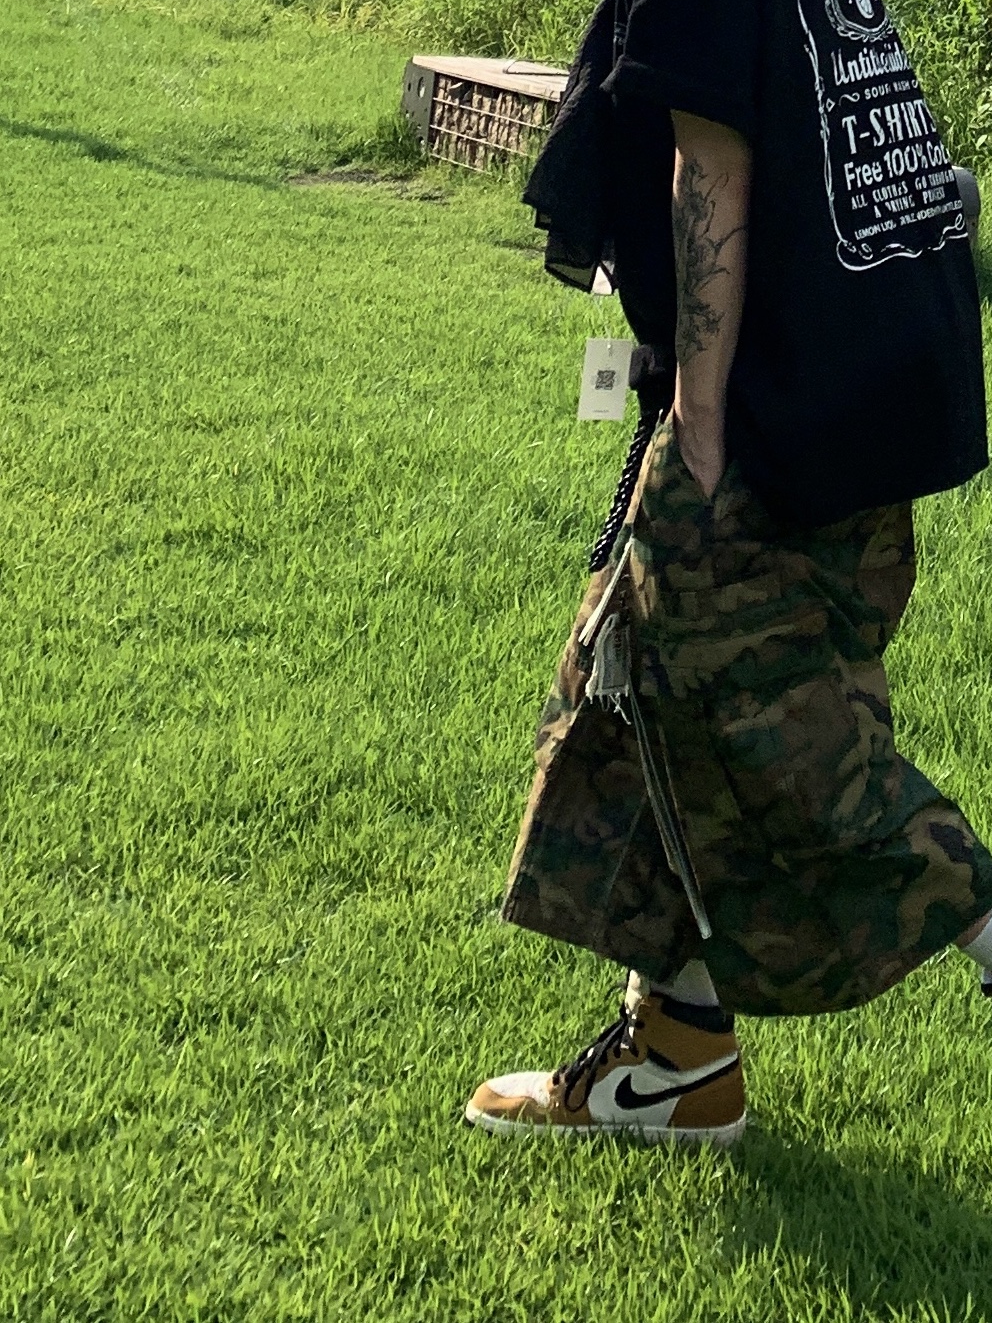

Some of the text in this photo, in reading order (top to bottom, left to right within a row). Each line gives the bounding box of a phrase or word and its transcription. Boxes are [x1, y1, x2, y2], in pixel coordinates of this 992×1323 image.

[851, 194, 868, 210] ALL
[915, 176, 928, 191] GO
[874, 205, 882, 218] A
